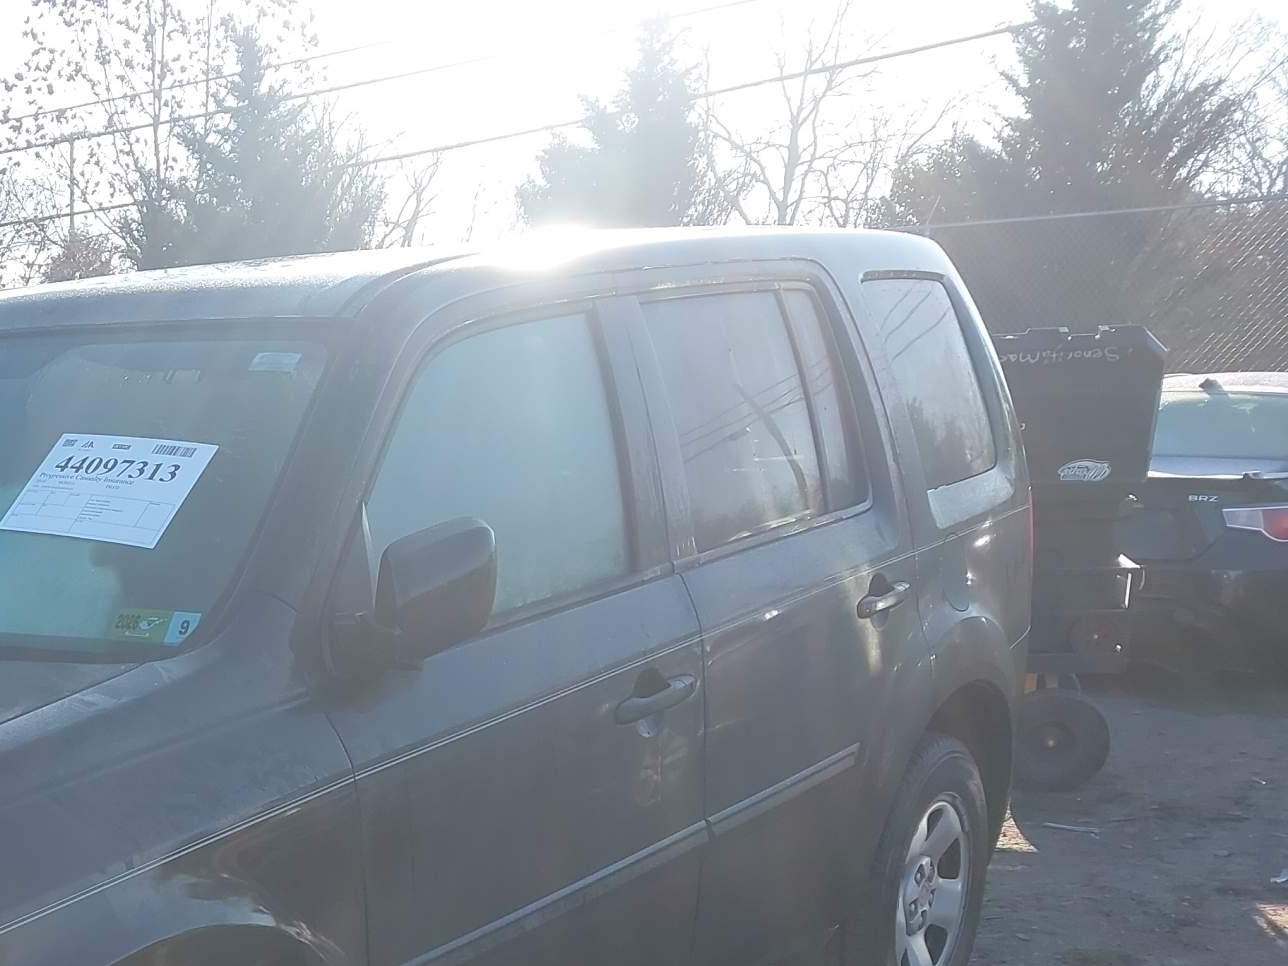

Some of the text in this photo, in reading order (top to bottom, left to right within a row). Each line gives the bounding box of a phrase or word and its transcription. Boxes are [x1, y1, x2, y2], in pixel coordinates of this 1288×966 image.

[55, 455, 181, 483] 44097313
[40, 472, 74, 481] Progressive
[75, 474, 102, 483] Casualty
[103, 477, 135, 486] Insurance
[1188, 495, 1219, 503] BRZ
[178, 620, 191, 636] 9
